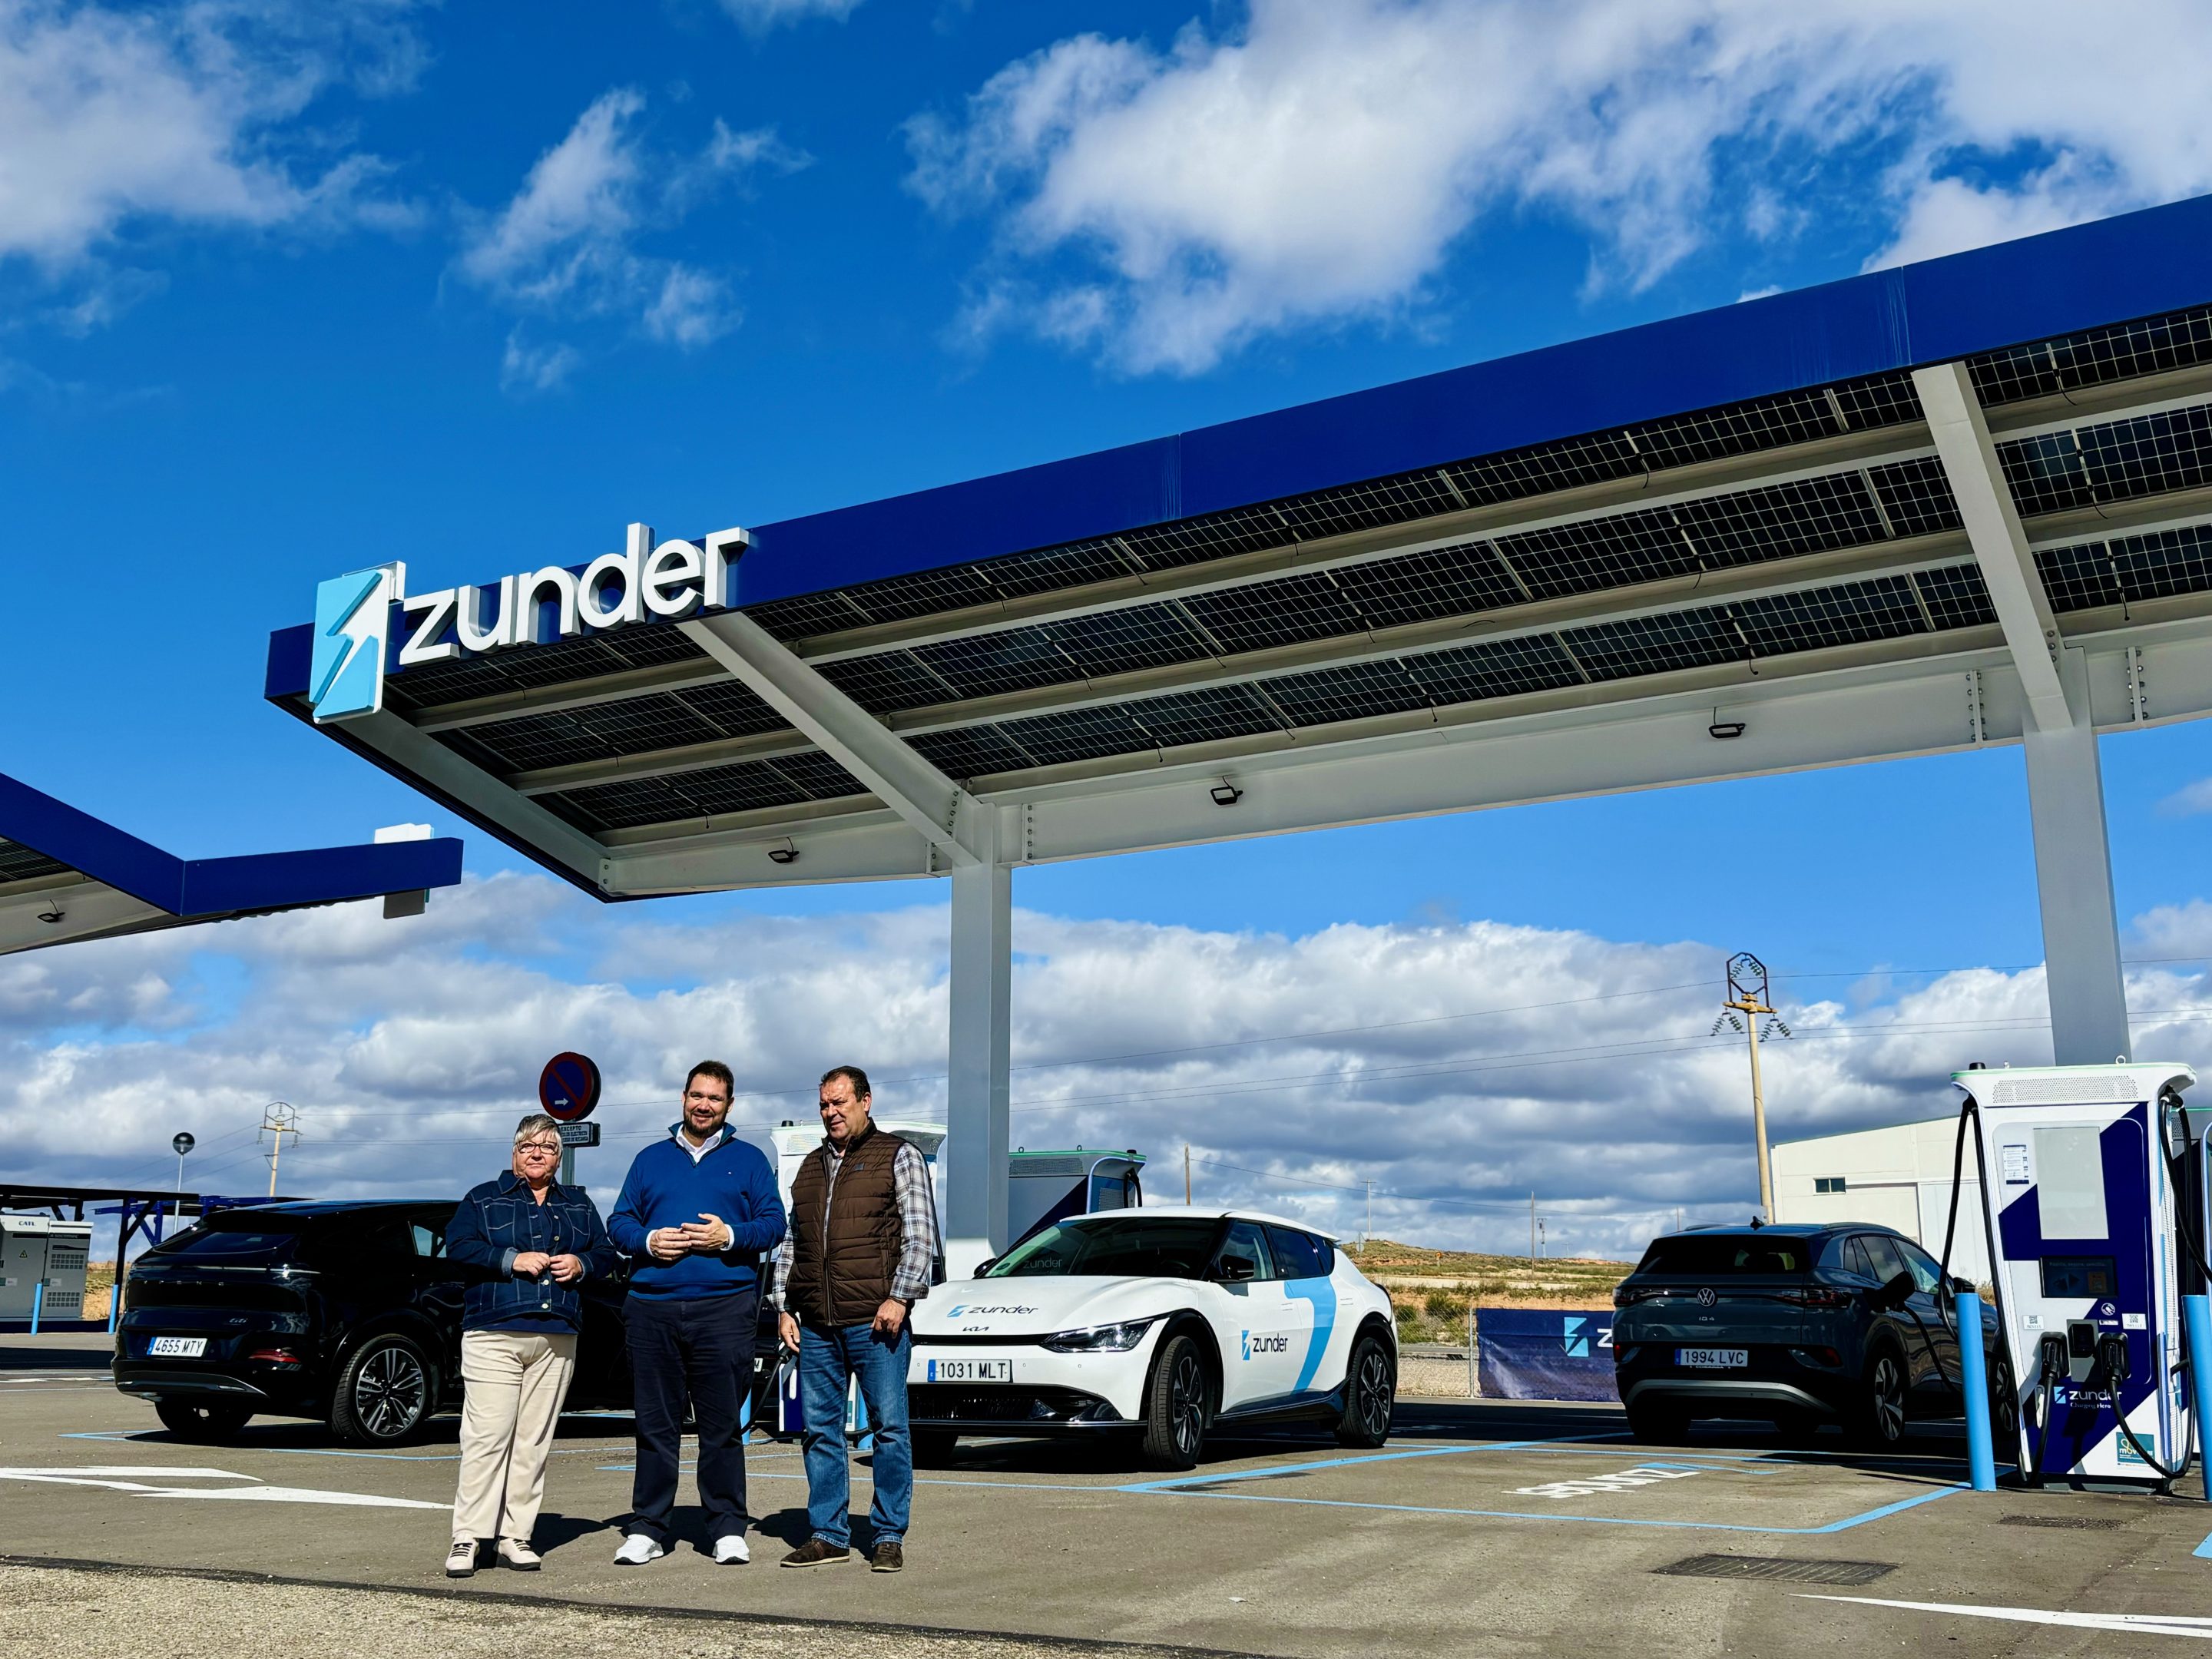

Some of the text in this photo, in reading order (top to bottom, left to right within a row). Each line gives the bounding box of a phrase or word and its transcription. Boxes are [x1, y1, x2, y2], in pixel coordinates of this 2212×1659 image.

[399, 522, 749, 666] zunder
[968, 1305, 1039, 1314] zunder
[155, 1339, 204, 1354] 4655 MTY
[1253, 1333, 1289, 1353] zunder
[1685, 1351, 1715, 1364] 1994
[1719, 1351, 1743, 1364] LVC
[940, 1363, 1006, 1379] 1031 MLT
[2068, 1389, 2122, 1401] zundr
